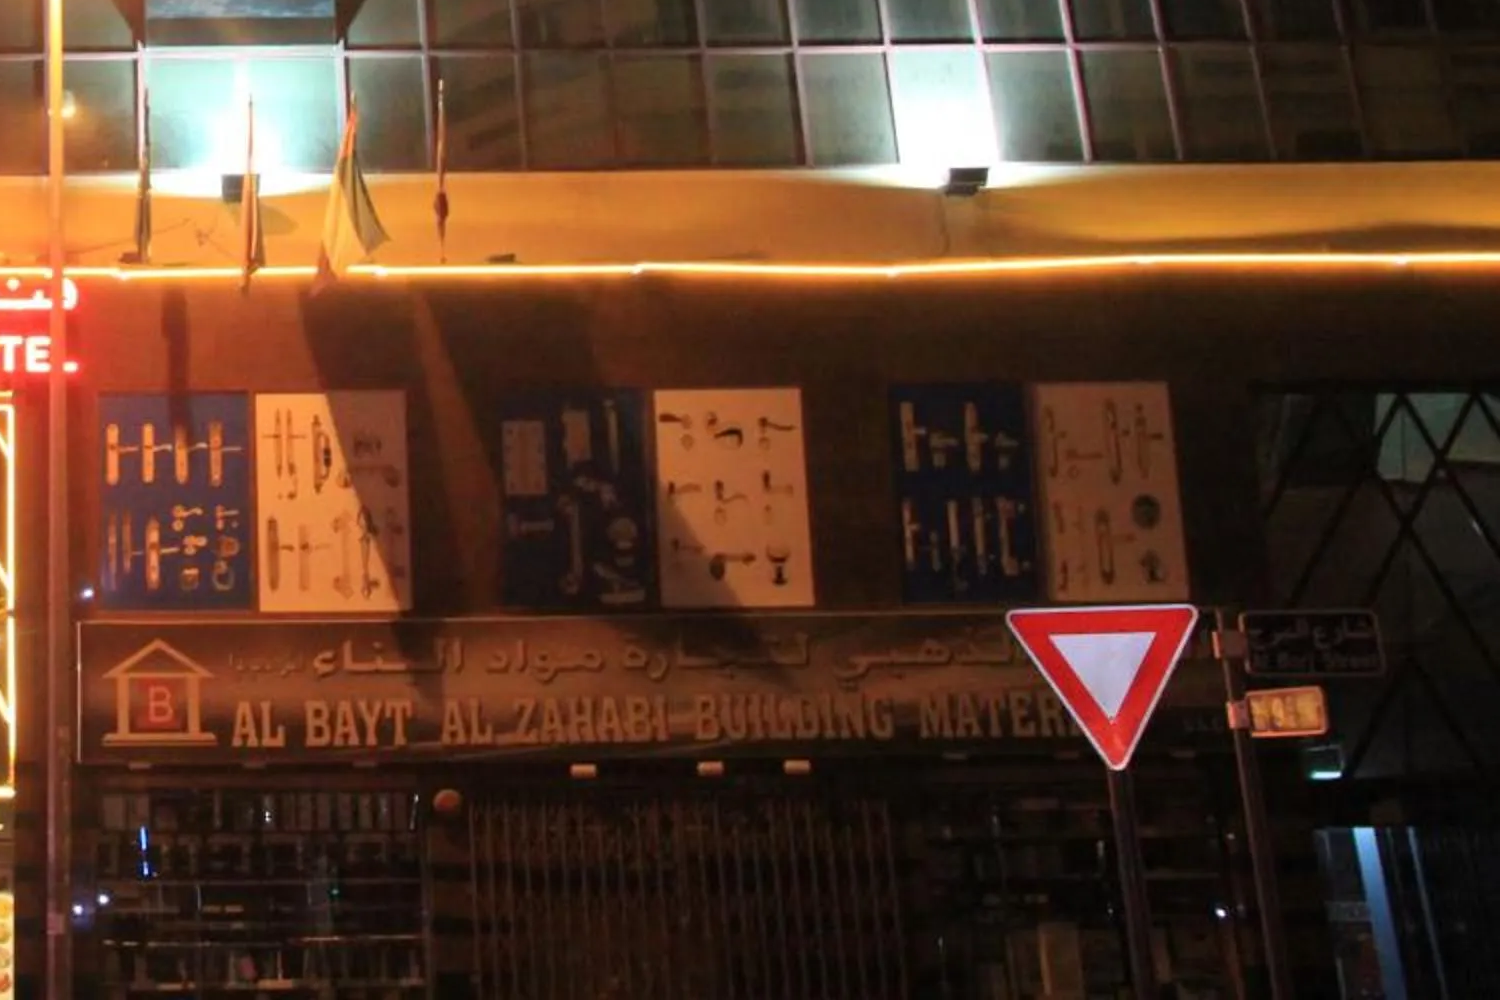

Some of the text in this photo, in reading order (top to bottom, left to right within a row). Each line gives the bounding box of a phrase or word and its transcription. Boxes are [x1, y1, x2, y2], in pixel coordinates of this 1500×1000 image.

[232, 701, 285, 747] AL
[305, 701, 412, 747] BAYT
[441, 700, 494, 745] AL
[512, 697, 670, 743] ZAHABI
[694, 696, 895, 740] BUILDING
